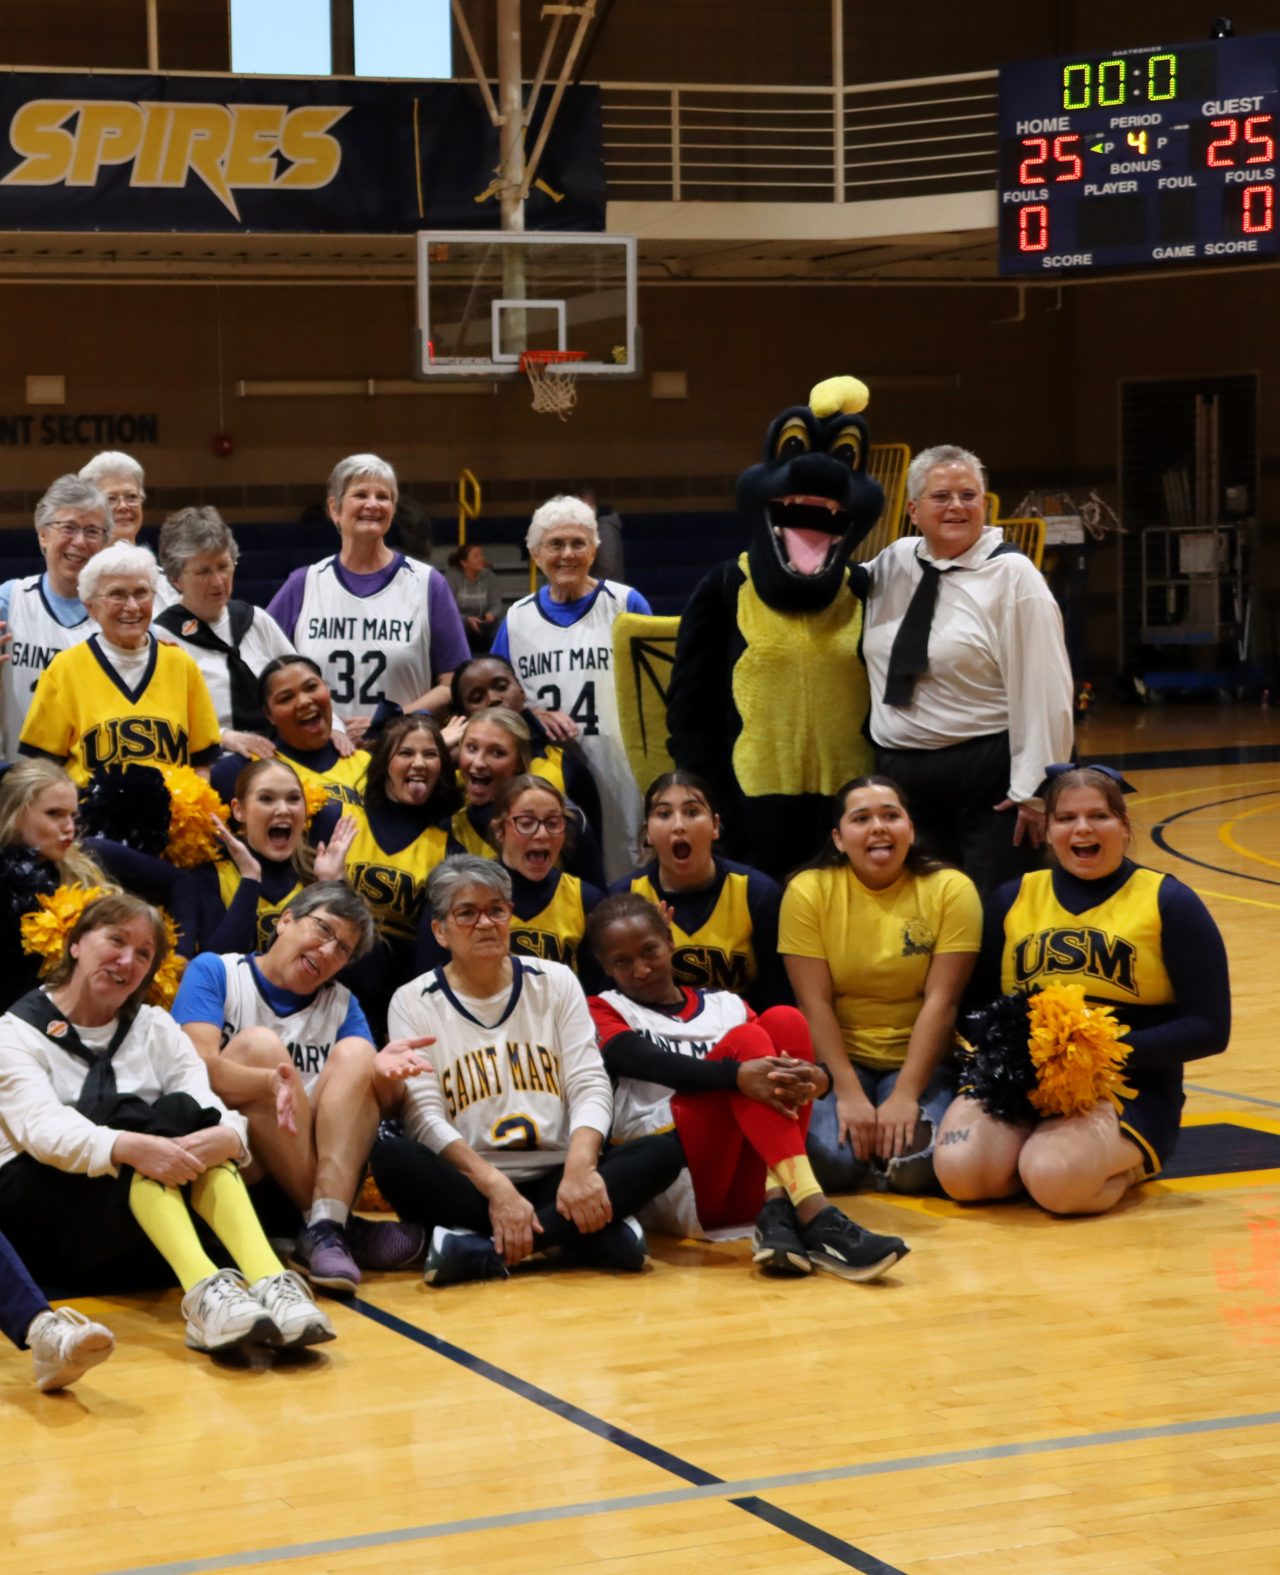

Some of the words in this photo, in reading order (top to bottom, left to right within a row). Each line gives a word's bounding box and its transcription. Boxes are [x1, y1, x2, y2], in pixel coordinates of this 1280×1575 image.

[1201, 96, 1264, 117] GUEST
[1016, 116, 1070, 135] HOME
[1110, 113, 1162, 129] PERIOD
[1104, 142, 1114, 154] P
[1126, 130, 1148, 155] 4
[1157, 137, 1168, 149] P
[1207, 114, 1275, 168] 25
[1019, 134, 1082, 185] 25
[1110, 159, 1161, 175] BONUS
[1084, 180, 1138, 196] PLAYER
[1158, 175, 1197, 190] FOUL
[1225, 168, 1275, 184] FOULS
[1003, 188, 1049, 203] FOULS
[1242, 184, 1274, 234] 0
[1019, 205, 1049, 252] 0
[1042, 254, 1093, 268] SCORE
[1152, 244, 1195, 260] GAME
[1204, 240, 1258, 256] SCORE
[40, 413, 158, 445] SECTION
[308, 617, 357, 640] SAINT
[362, 618, 414, 643] MARY
[518, 650, 564, 679] SAINT
[569, 647, 613, 671] MAR
[328, 650, 387, 705] 32
[81, 716, 191, 774] USM
[671, 945, 752, 989] SM
[1013, 926, 1140, 997] USM
[442, 1046, 502, 1119] SAINT
